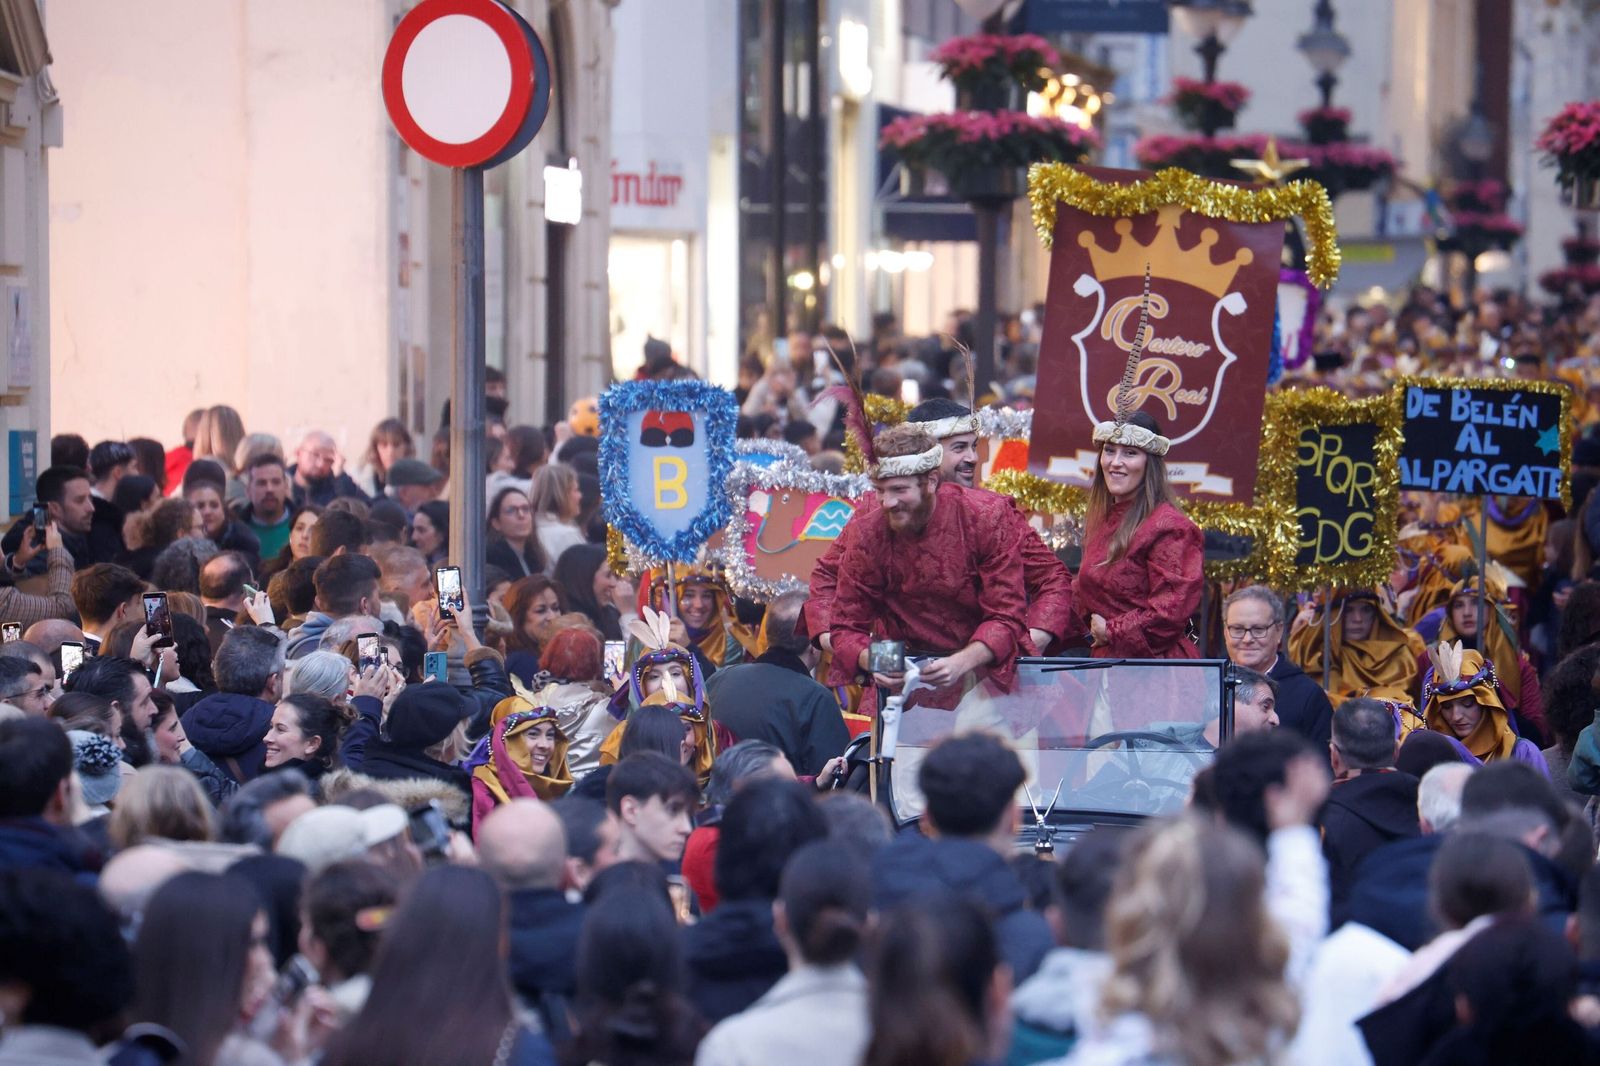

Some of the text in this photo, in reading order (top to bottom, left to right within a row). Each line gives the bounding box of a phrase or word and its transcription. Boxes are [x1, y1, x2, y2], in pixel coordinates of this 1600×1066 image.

[1101, 293, 1209, 357] Cartero
[1107, 358, 1208, 421] Real
[1407, 387, 1538, 429] DE BELÉN
[1456, 423, 1500, 454] AL
[653, 456, 688, 509] B
[1298, 425, 1375, 508] SPQR
[1397, 457, 1562, 498] ALPARGATE
